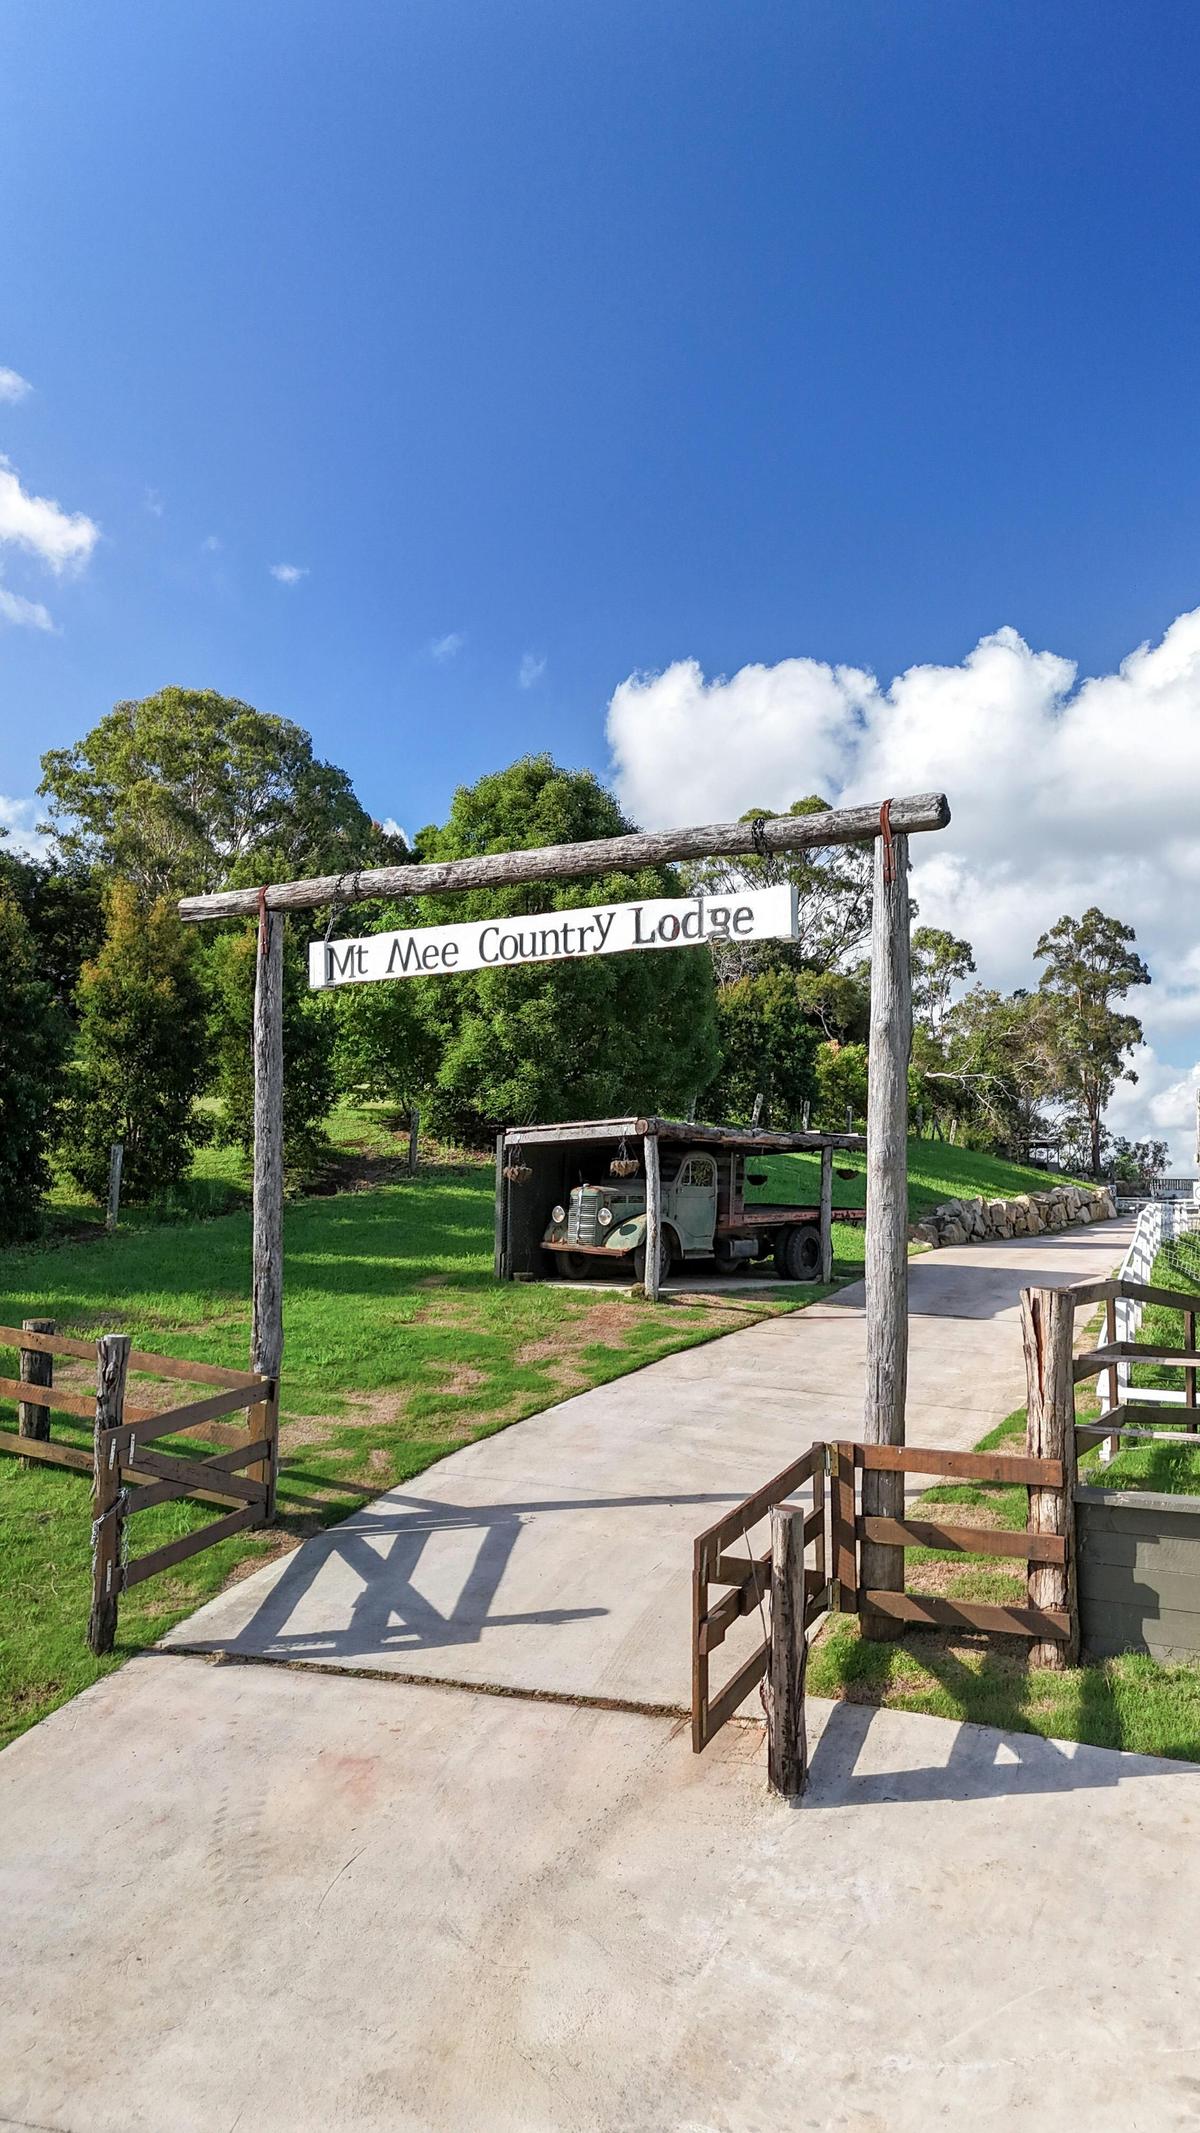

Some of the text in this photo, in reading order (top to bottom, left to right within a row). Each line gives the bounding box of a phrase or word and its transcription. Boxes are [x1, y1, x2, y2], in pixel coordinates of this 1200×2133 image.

[327, 898, 754, 981] Mt Mee Country Lodge
